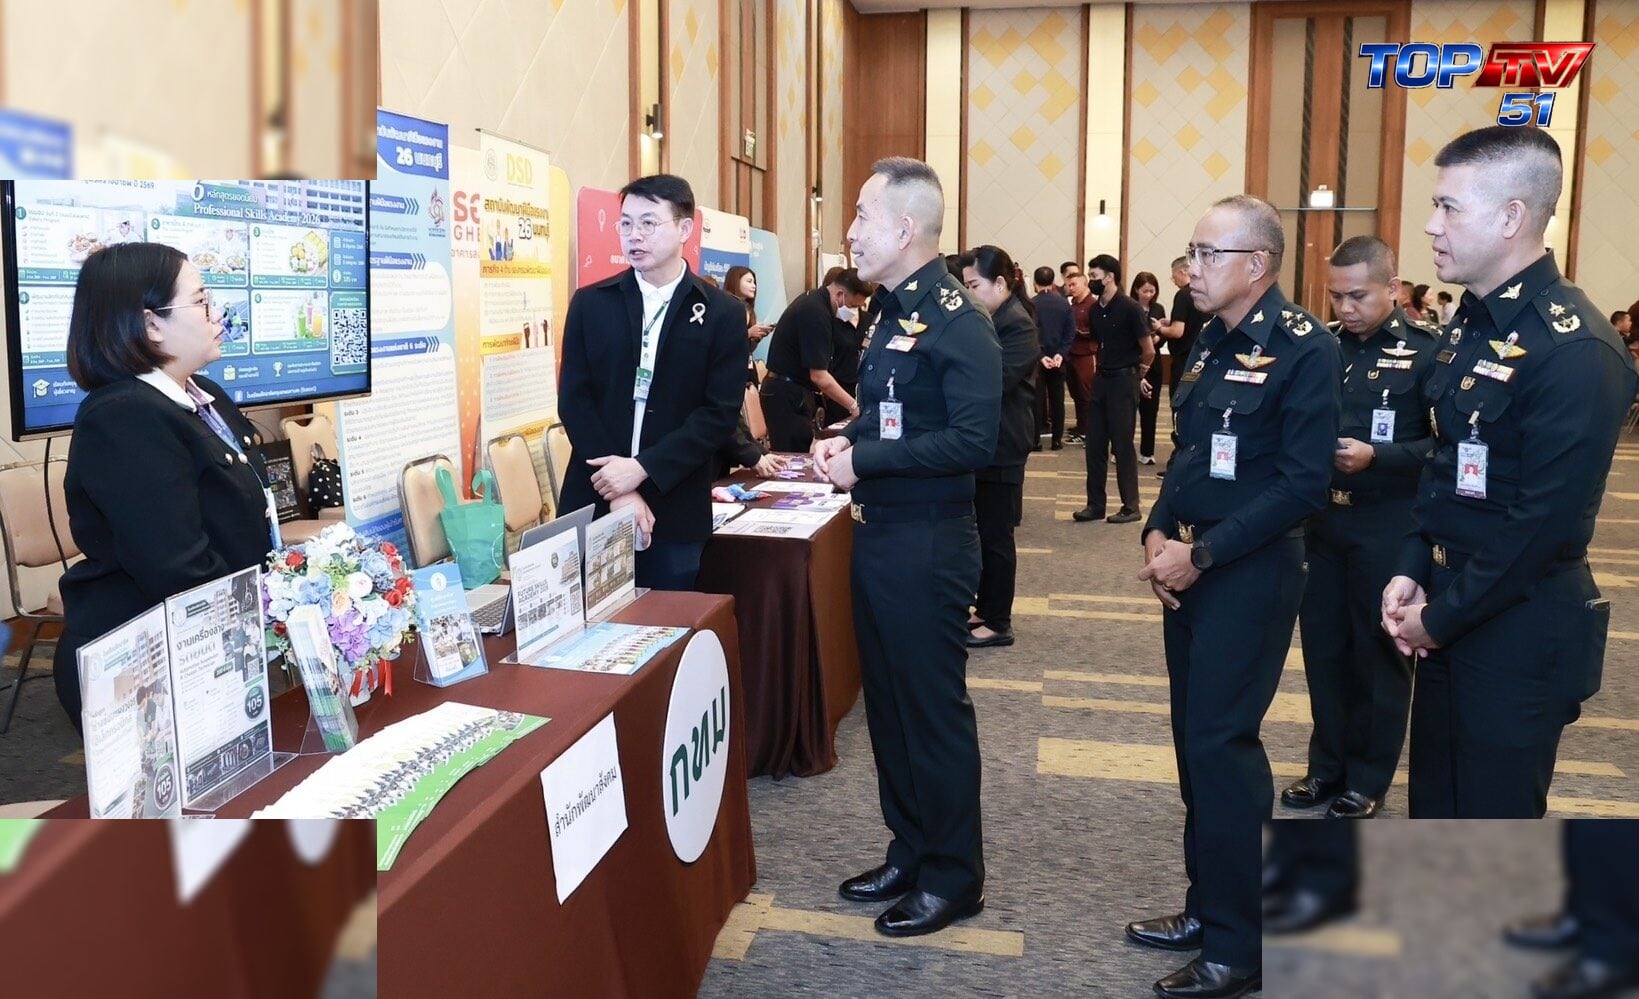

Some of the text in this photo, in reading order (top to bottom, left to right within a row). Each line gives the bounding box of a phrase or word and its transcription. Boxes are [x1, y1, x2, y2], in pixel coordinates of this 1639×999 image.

[396, 146, 414, 166] 26
[506, 153, 533, 185] DSD
[194, 202, 320, 225] Professional Skills Academy 2026
[518, 217, 532, 240] 26
[176, 623, 225, 650] งานเครื่องล่าง
[247, 695, 262, 713] 105
[157, 776, 172, 799] 105
[554, 766, 617, 838] สำนักพัฒนาสังคม
